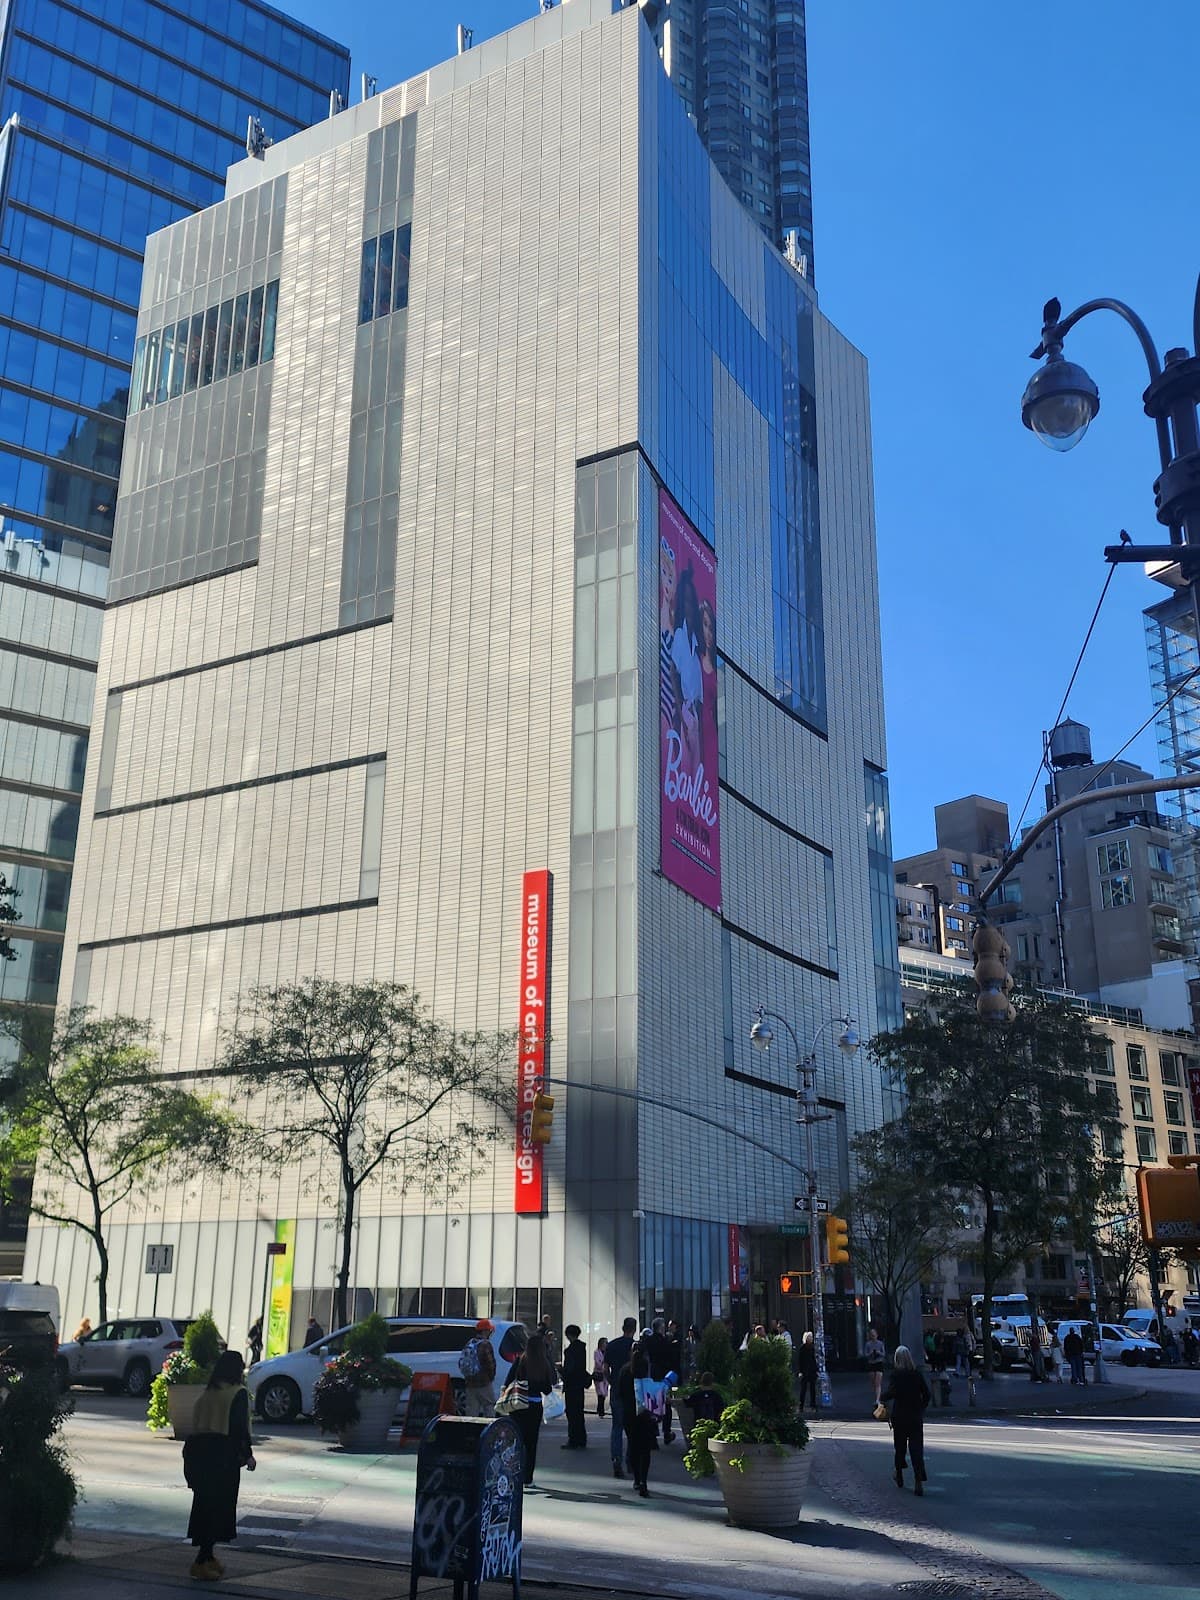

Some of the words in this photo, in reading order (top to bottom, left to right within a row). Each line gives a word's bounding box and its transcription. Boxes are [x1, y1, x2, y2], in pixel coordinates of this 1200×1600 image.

[665, 729, 717, 826] Barbie
[675, 823, 711, 860] EXHIBITION
[527, 894, 539, 980] museum
[525, 985, 542, 1007] of
[524, 1012, 539, 1053] arts
